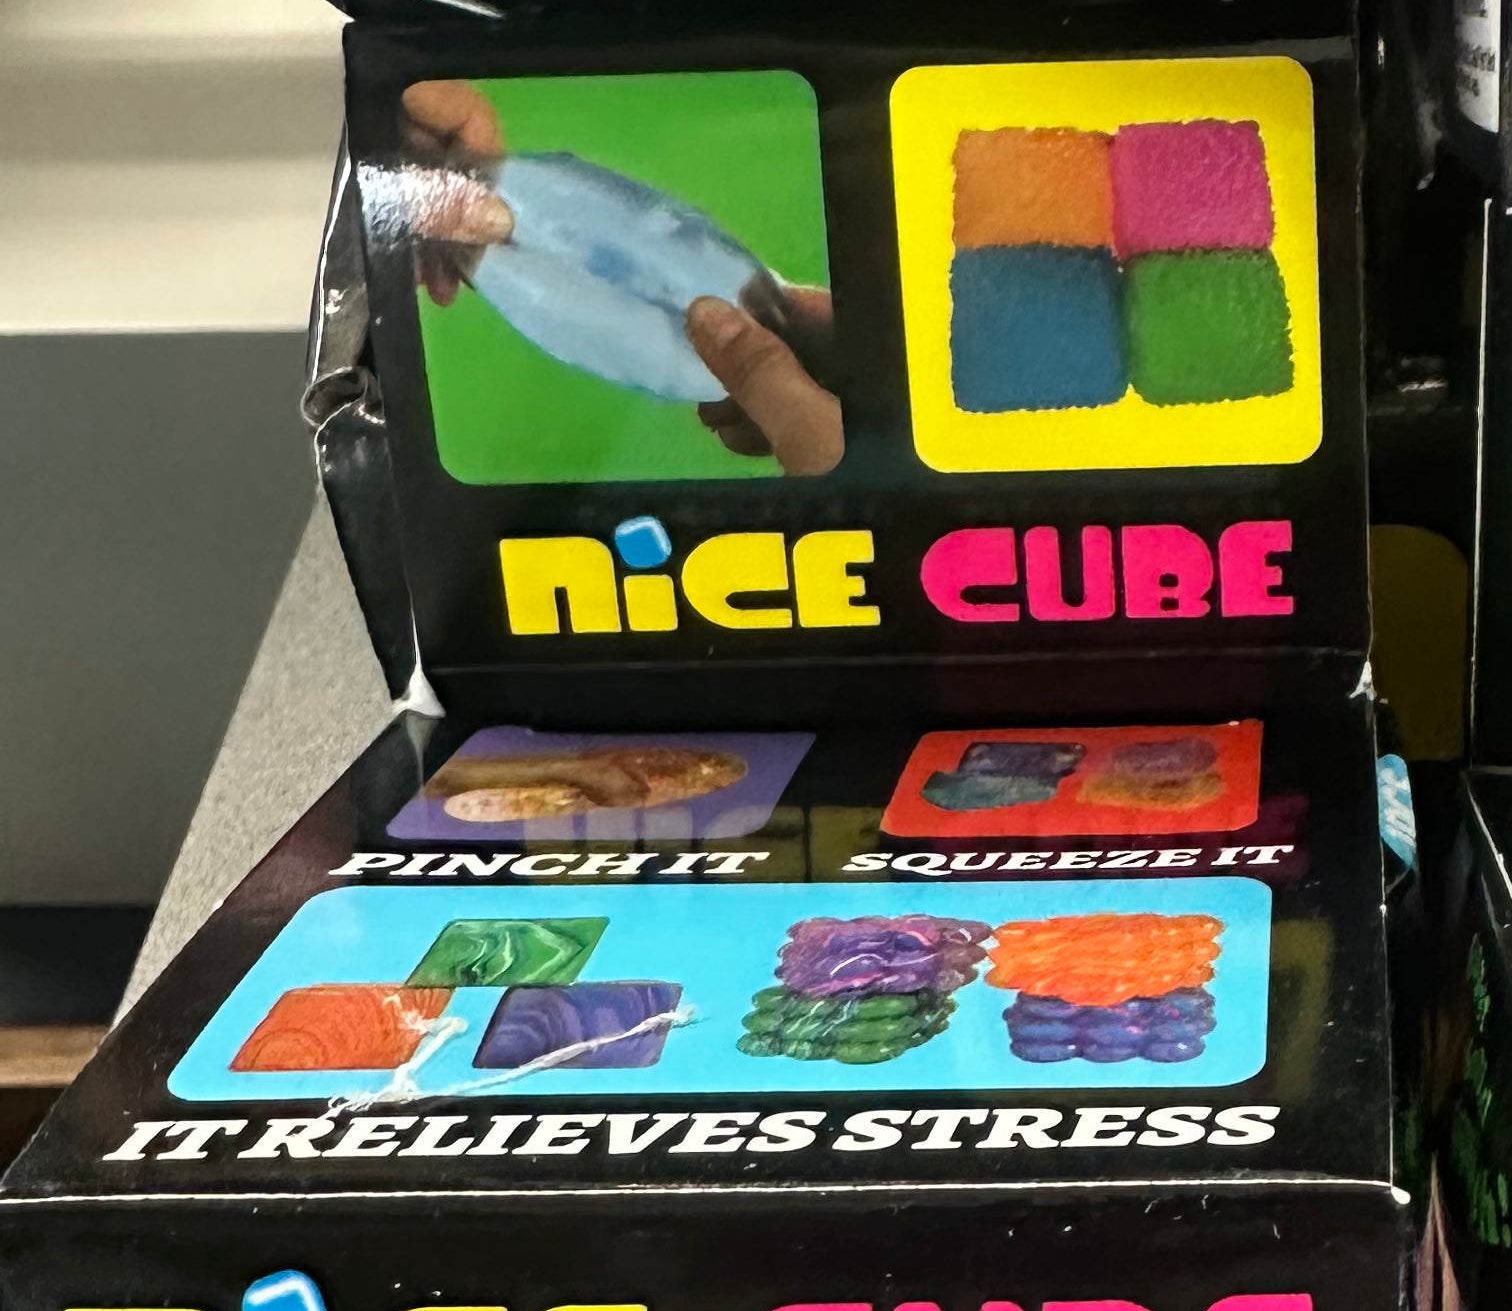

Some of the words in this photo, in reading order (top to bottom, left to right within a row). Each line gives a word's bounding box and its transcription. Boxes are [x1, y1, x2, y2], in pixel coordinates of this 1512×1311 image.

[920, 520, 1294, 623] CUBE
[328, 852, 660, 877] PINCH
[657, 851, 771, 875] IT
[841, 848, 1203, 877] SQUEEZE
[1210, 845, 1295, 866] IT
[102, 1119, 249, 1161] IT
[236, 1110, 828, 1159] RELIEVES
[831, 1105, 1281, 1152] STRESS
